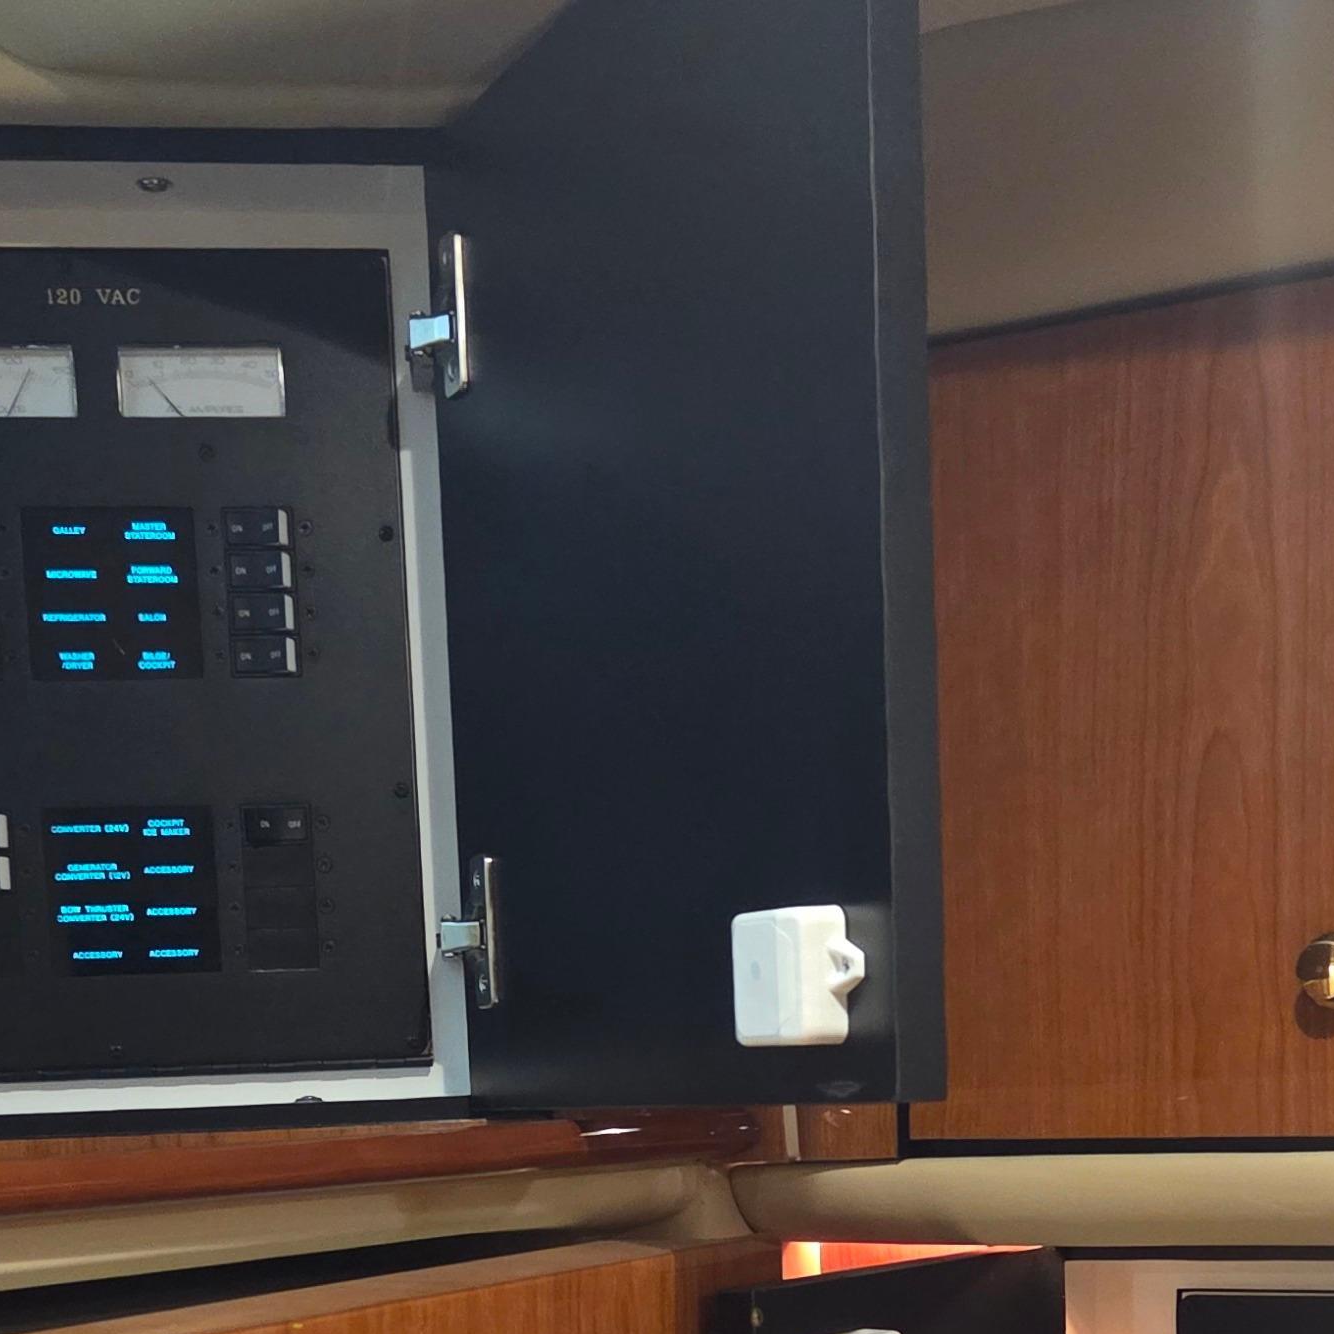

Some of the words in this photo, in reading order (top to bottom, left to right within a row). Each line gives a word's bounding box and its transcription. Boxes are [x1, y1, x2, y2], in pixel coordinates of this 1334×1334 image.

[47, 287, 82, 306] 120
[95, 287, 142, 306] VAC
[52, 526, 86, 535] GALLEY
[132, 522, 166, 531] MASTER
[124, 532, 175, 540] STATEROOM
[46, 570, 97, 579] MICROWAVE
[130, 566, 172, 574] FORWARD
[127, 575, 178, 584] STATEROOM
[42, 612, 106, 621] REFRIGERATOR
[137, 612, 167, 621] SALON
[58, 652, 95, 660] WASHER
[137, 661, 176, 670] COCKPIT
[147, 818, 185, 827] COCKPIT
[51, 825, 102, 834] CONVERTER
[104, 823, 130, 833] (24V)
[160, 827, 191, 836] MAKER
[67, 862, 117, 871] GENERATOR
[143, 865, 195, 875] ACCESSORY
[54, 872, 106, 881] CONVERTER
[84, 904, 129, 913] THRUSTER
[147, 907, 198, 916] ACCESSORY
[56, 914, 107, 923] CONVERTER
[72, 950, 124, 960] ACCESSORY
[149, 948, 200, 958] ACCESSORY
